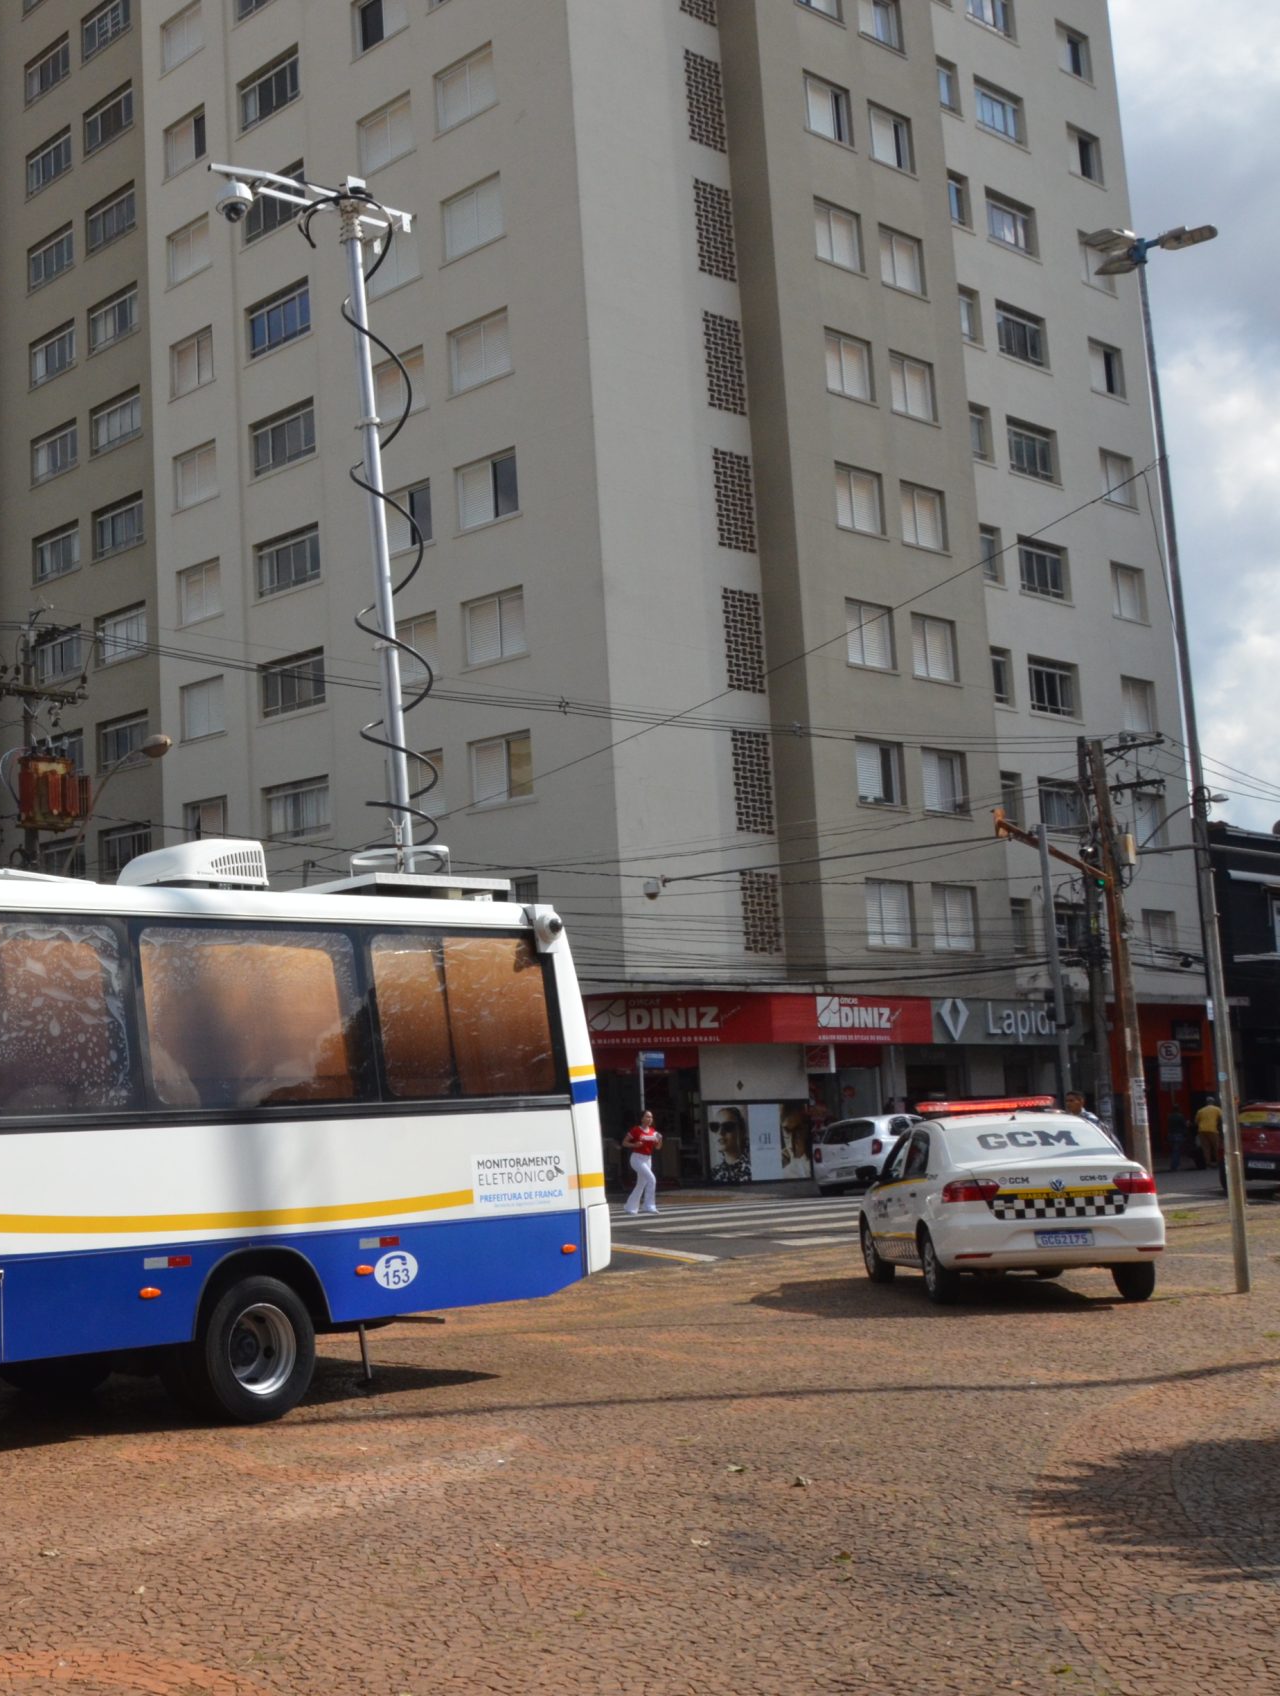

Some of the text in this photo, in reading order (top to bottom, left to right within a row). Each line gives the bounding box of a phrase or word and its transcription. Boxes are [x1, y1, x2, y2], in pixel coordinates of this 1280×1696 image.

[629, 1006, 719, 1030] DINIZ
[840, 1006, 891, 1029] DINIZ
[976, 1130, 1080, 1150] GCM
[477, 1155, 561, 1169] MONITORAMENTO
[1009, 1176, 1030, 1184] GCM
[479, 1189, 563, 1203] PREFEITURA DE FRANCA
[383, 1268, 410, 1286] 153
